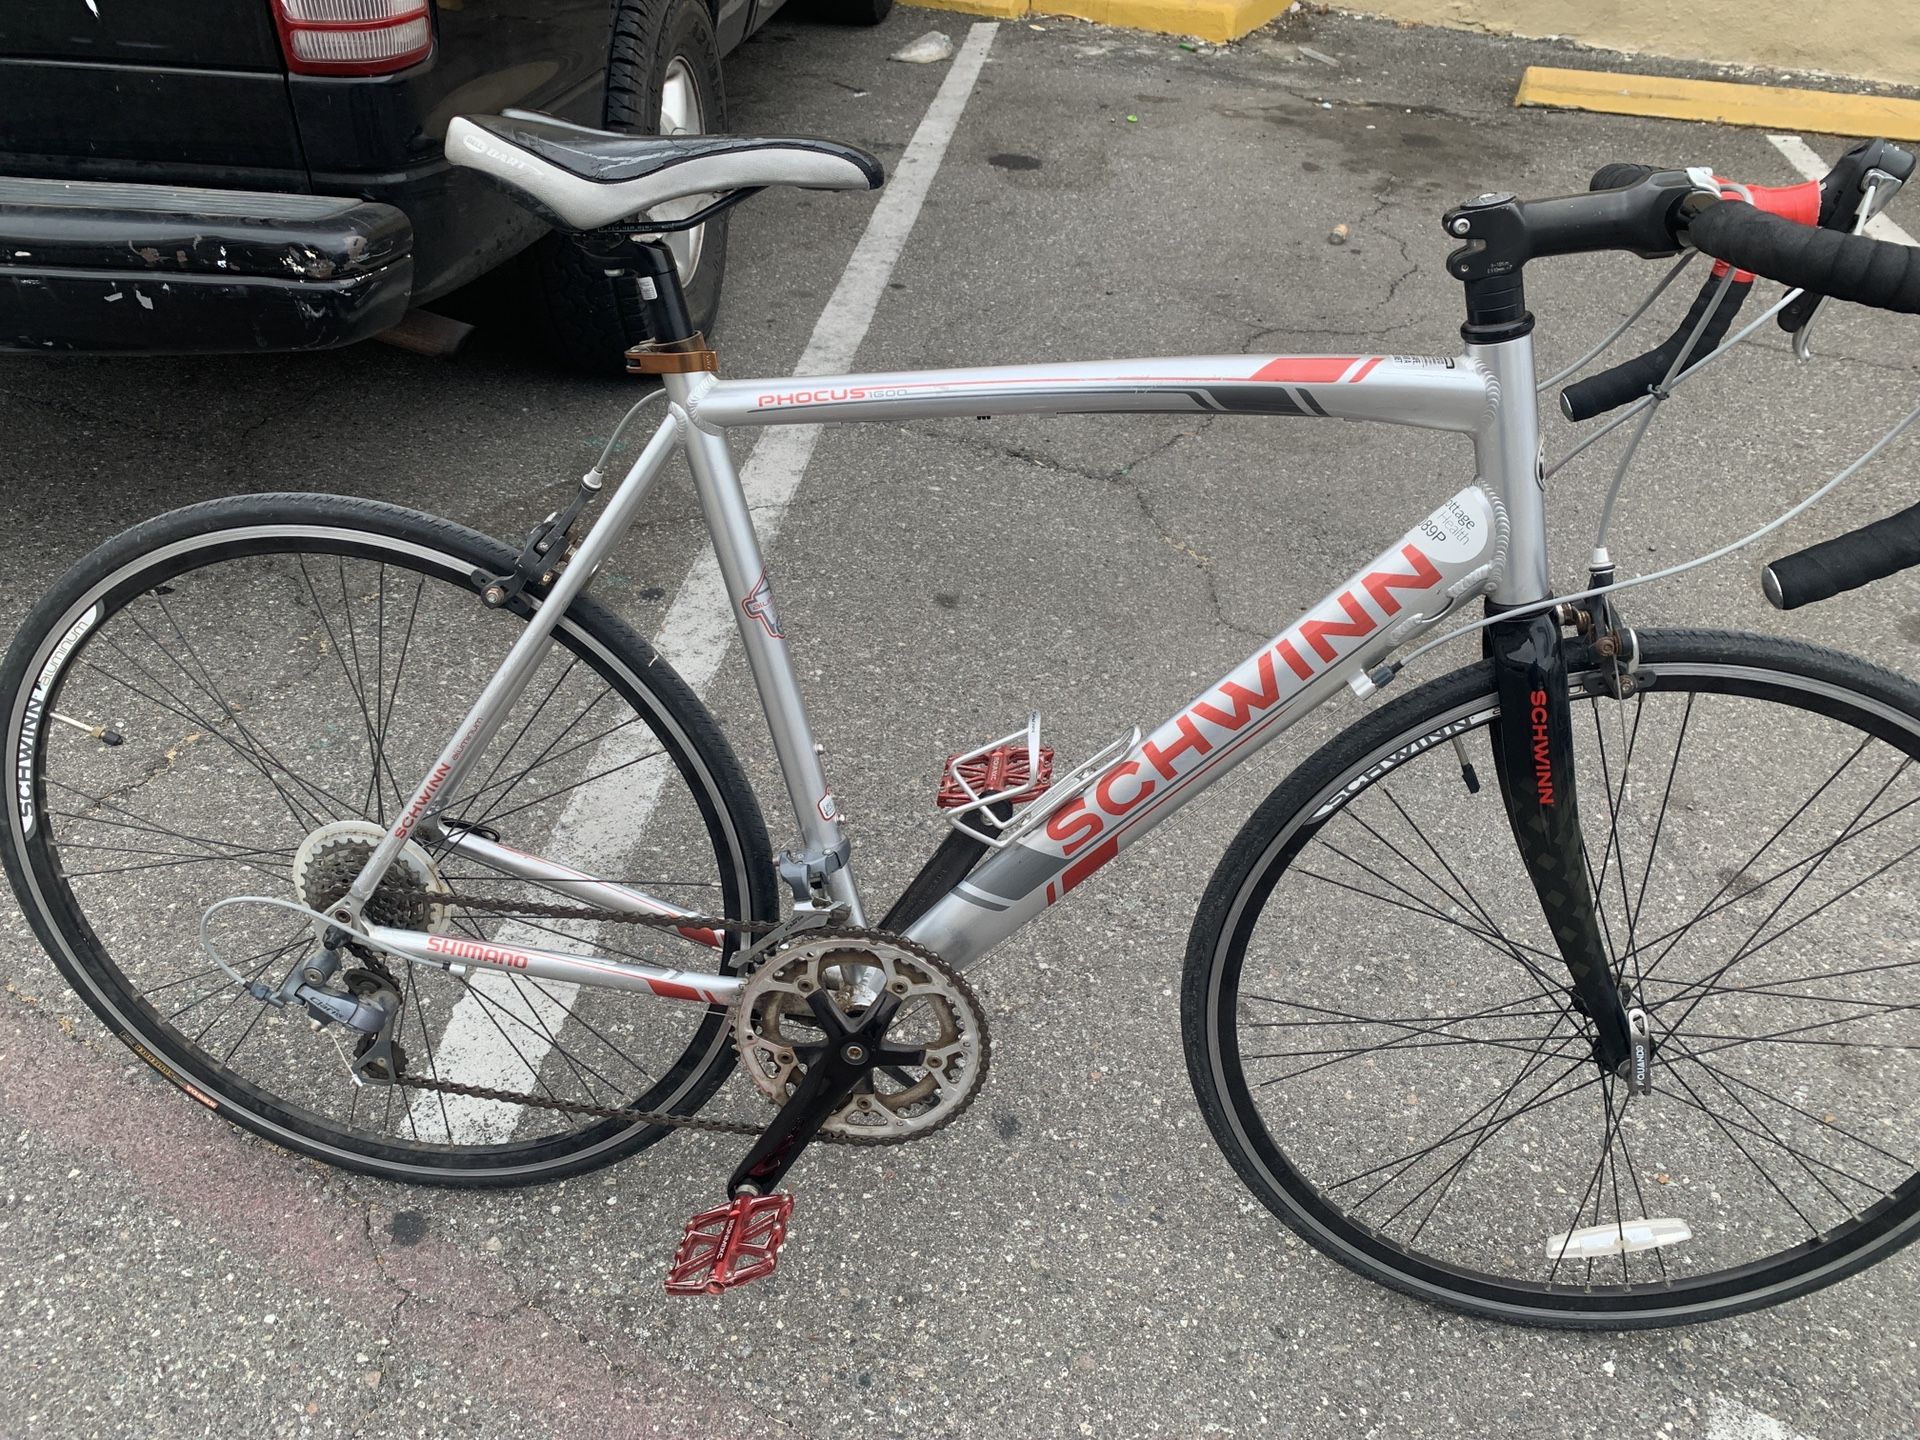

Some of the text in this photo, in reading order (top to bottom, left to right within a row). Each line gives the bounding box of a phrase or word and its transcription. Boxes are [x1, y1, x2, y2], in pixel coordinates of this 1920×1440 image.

[758, 389, 865, 407] PHOCUS
[1438, 510, 1470, 545] Health
[18, 621, 88, 817] SCHWINN aluminum
[1046, 544, 1443, 857] SCHWINN
[1328, 716, 1473, 809] SCHWINN
[1530, 690, 1554, 805] SCHWINN
[395, 763, 451, 839] SCHWINN
[427, 937, 528, 969] SHIMANO
[1636, 1045, 1645, 1080] QUANDO
